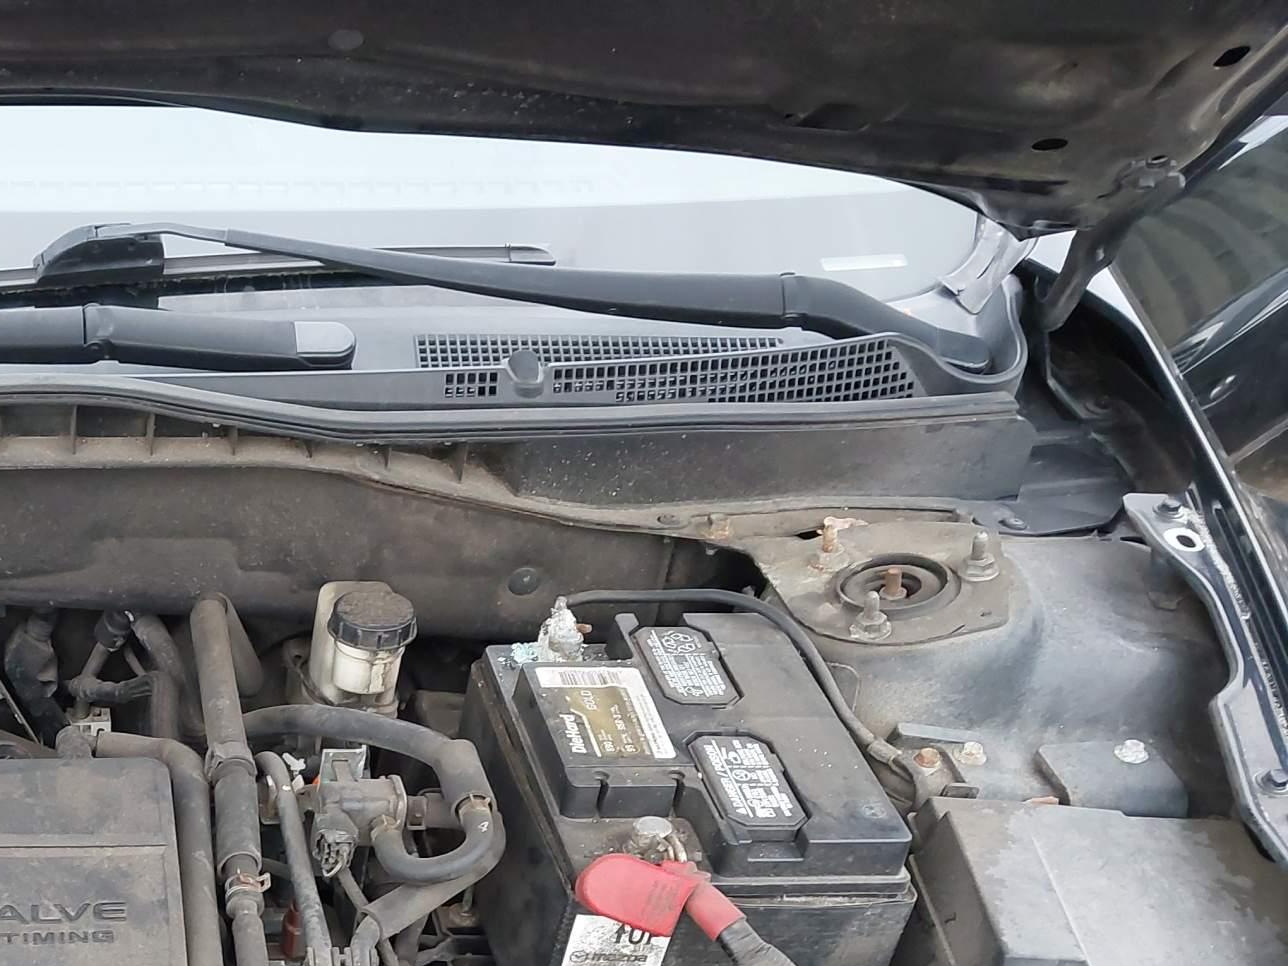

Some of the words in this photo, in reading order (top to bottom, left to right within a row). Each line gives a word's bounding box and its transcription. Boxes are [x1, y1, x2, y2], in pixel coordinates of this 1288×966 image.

[580, 690, 598, 711] GOLD
[558, 713, 588, 755] DieHard
[703, 745, 726, 772] POISON
[0, 929, 115, 946] TIMING
